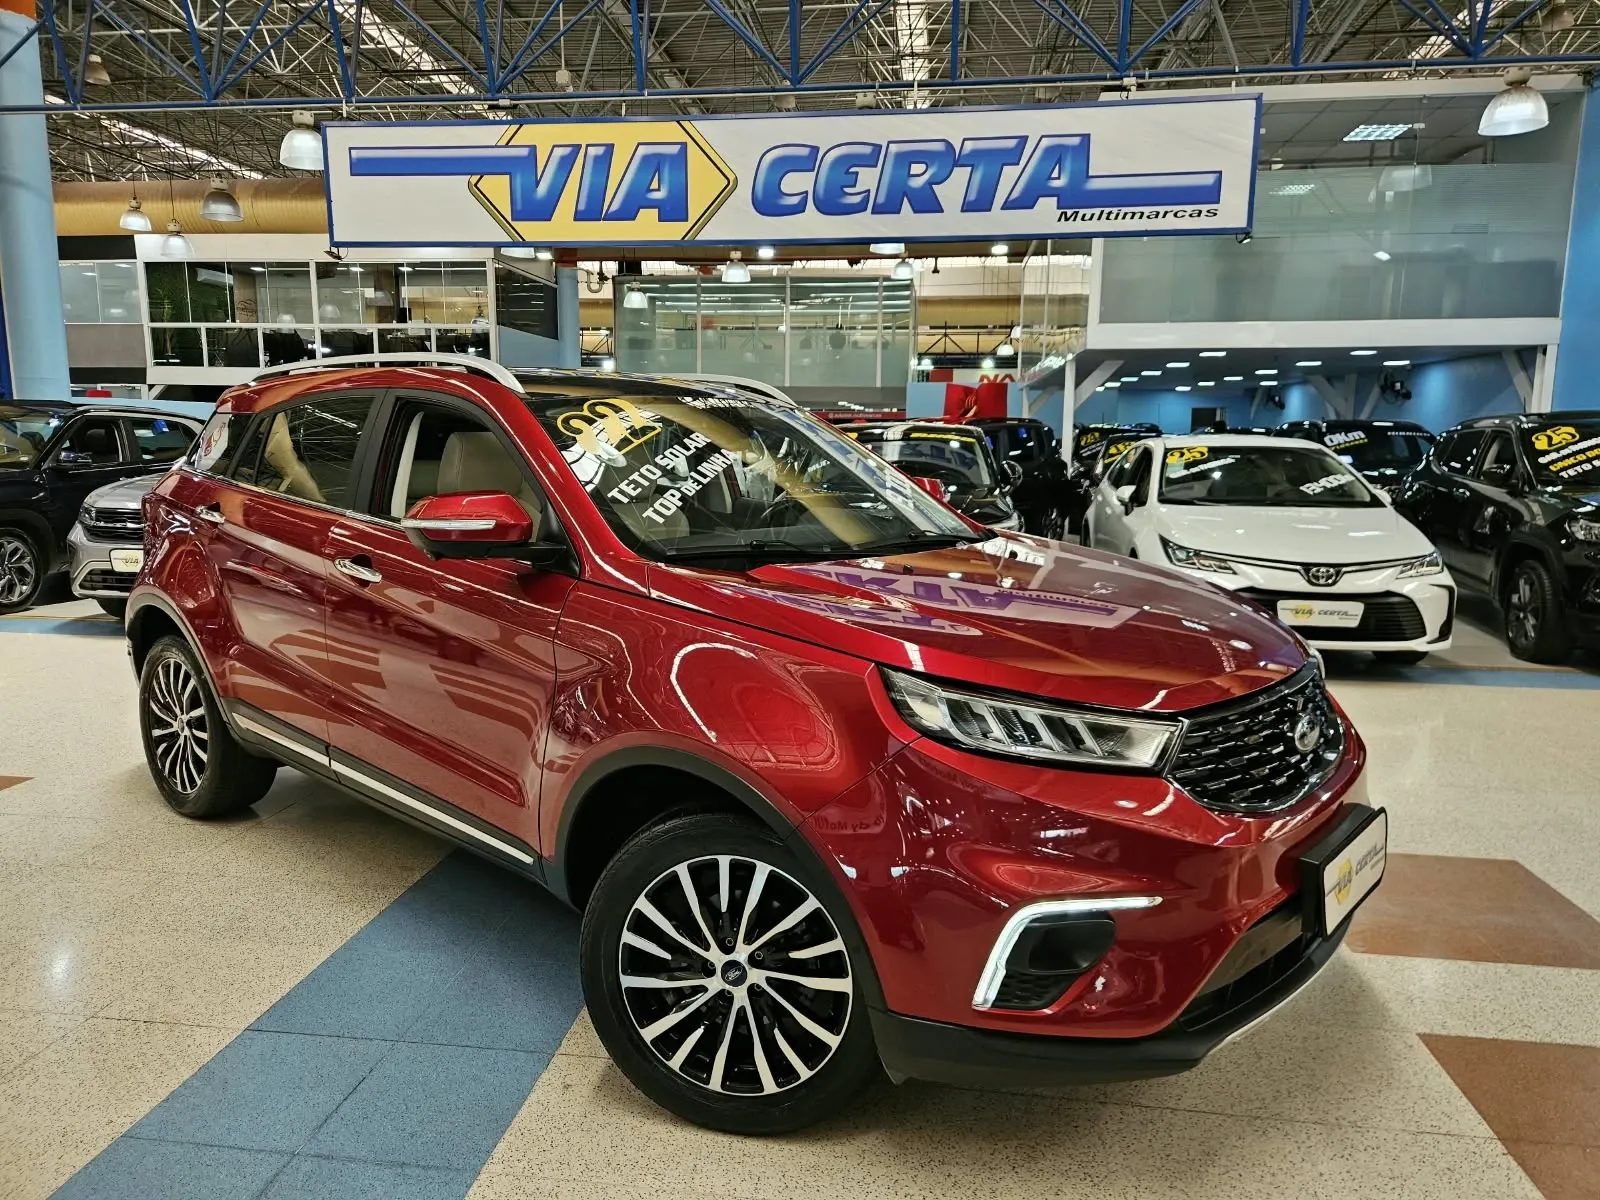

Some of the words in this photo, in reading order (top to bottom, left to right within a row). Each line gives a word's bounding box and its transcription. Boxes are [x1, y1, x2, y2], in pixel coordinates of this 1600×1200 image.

[349, 142, 688, 222] VIA
[751, 133, 1222, 218] CERTA
[1057, 206, 1220, 224] Multimarcas
[607, 463, 662, 504] TETO
[654, 431, 712, 470] SOLAR
[1532, 426, 1580, 450] 25
[642, 489, 684, 524] TOP
[680, 471, 703, 497] DE
[696, 448, 734, 486] LINHA
